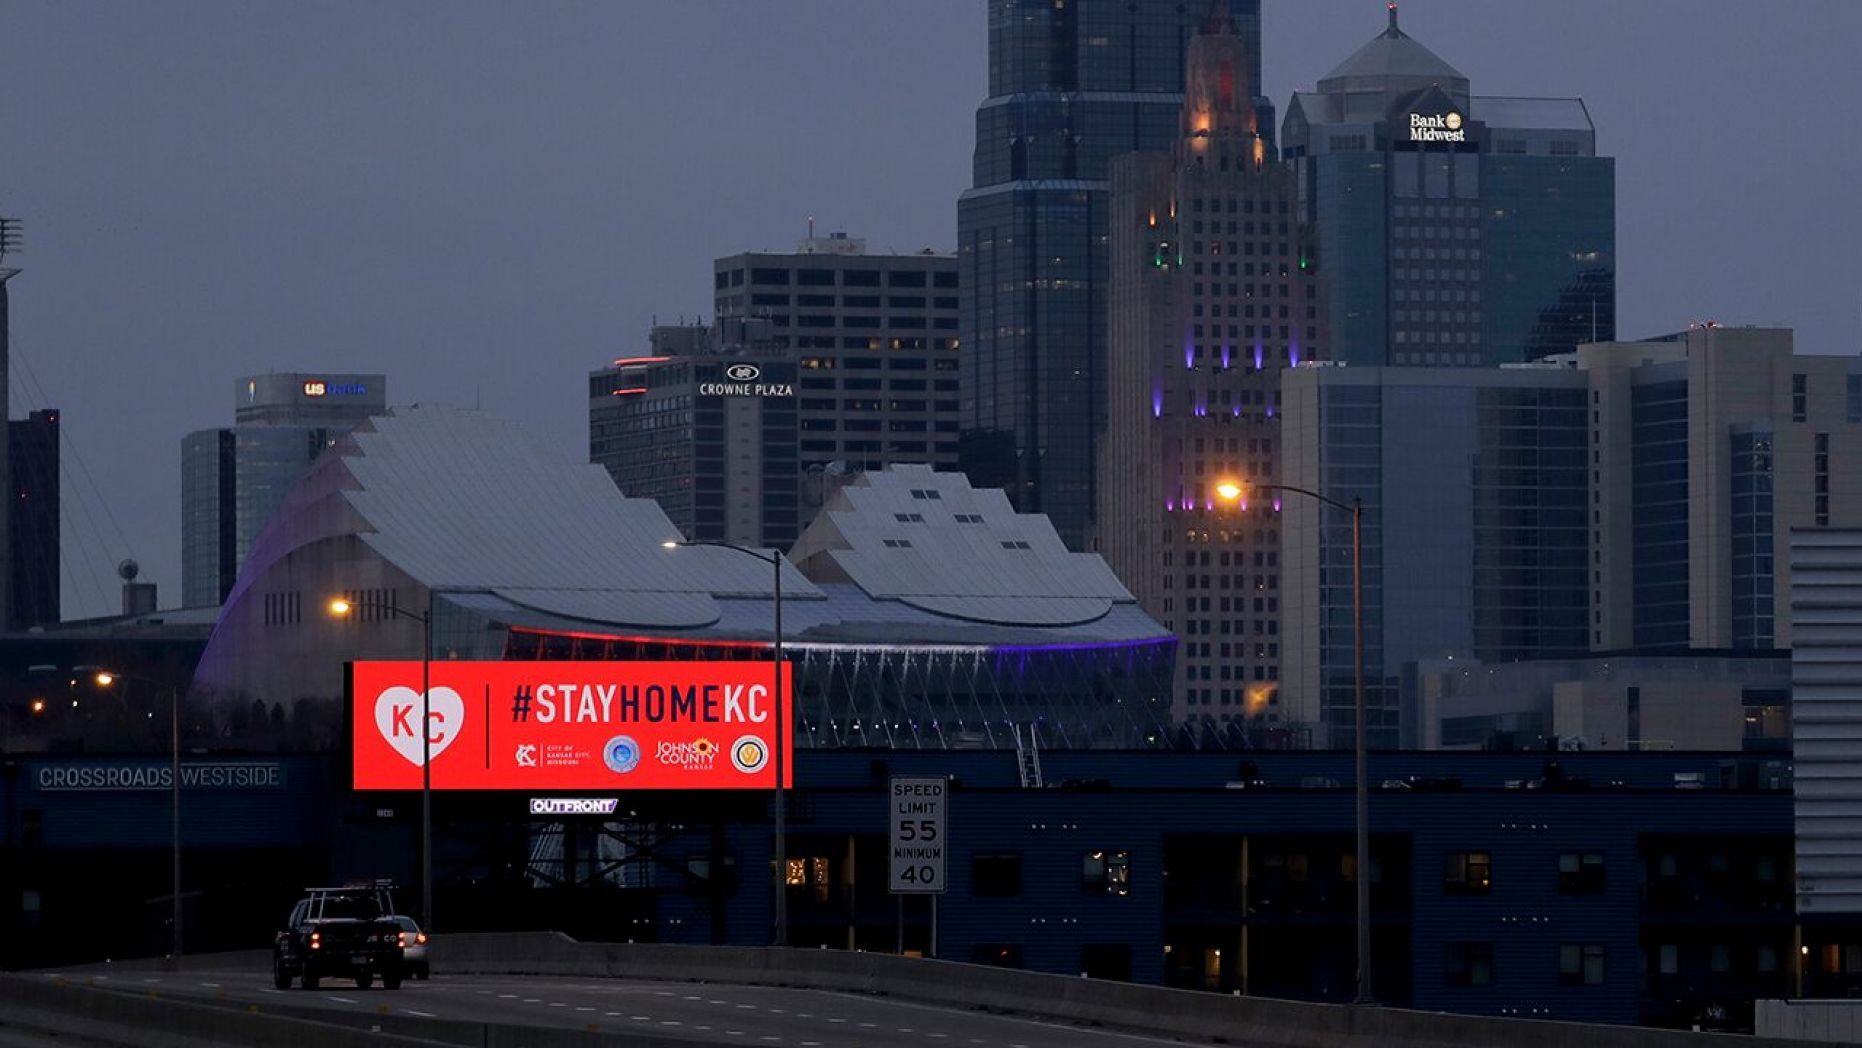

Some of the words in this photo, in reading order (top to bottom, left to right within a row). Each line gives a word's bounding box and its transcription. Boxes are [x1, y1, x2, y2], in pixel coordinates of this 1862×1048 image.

[1410, 113, 1445, 127] Bank
[1410, 127, 1464, 141] Midwest
[700, 383, 751, 396] CROWNE
[755, 384, 793, 396] PLAZA
[512, 684, 768, 723] #STAYHOMEKC
[660, 753, 716, 765] COUNTY
[40, 767, 173, 787] CROSSROADS
[180, 766, 280, 786] WESTSIDE
[894, 784, 942, 796] SPEED
[533, 800, 614, 813] OUTFRONT
[899, 802, 936, 814] LIMIT
[900, 820, 937, 841] 55
[894, 848, 941, 859] MINIMUM
[900, 864, 935, 884] 40
